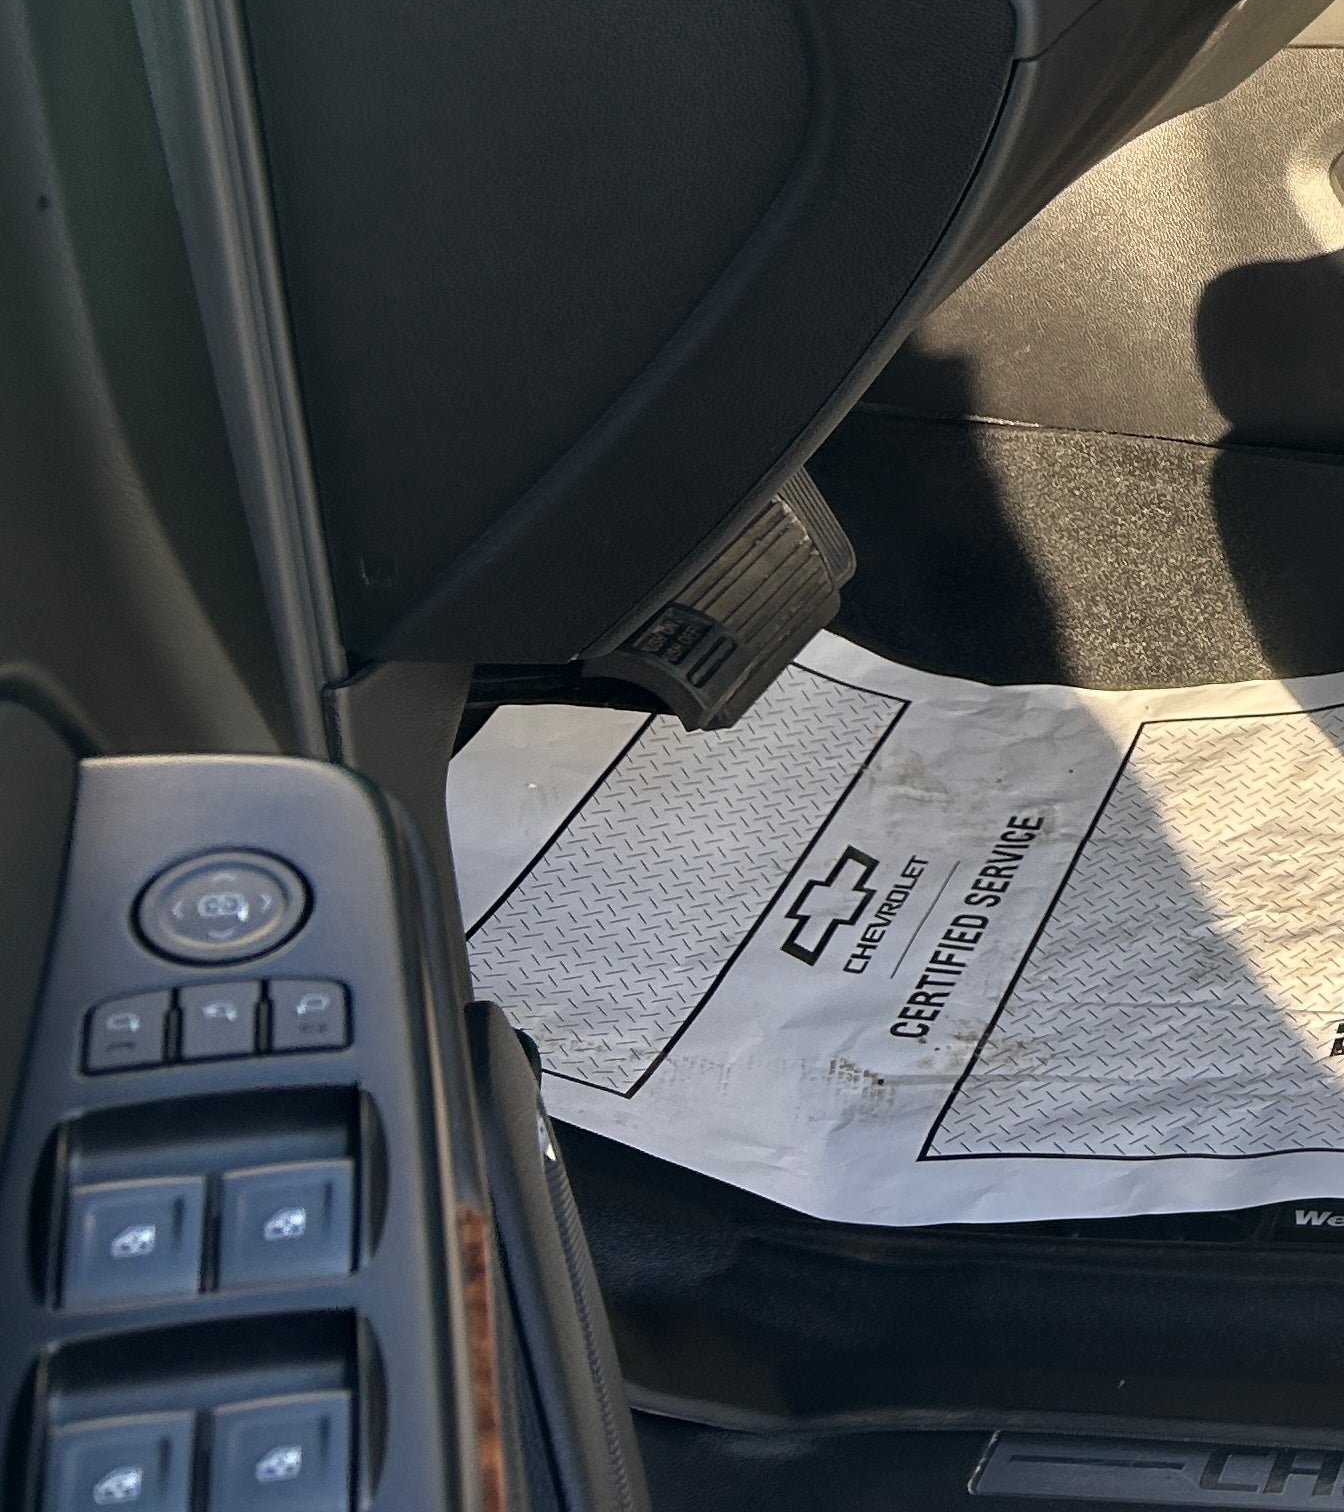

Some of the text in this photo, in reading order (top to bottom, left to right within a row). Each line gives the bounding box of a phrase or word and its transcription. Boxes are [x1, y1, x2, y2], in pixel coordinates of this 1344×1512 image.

[843, 855, 929, 974] CHEVROLET
[889, 815, 1046, 1039] CERTIFIED SERVICE
